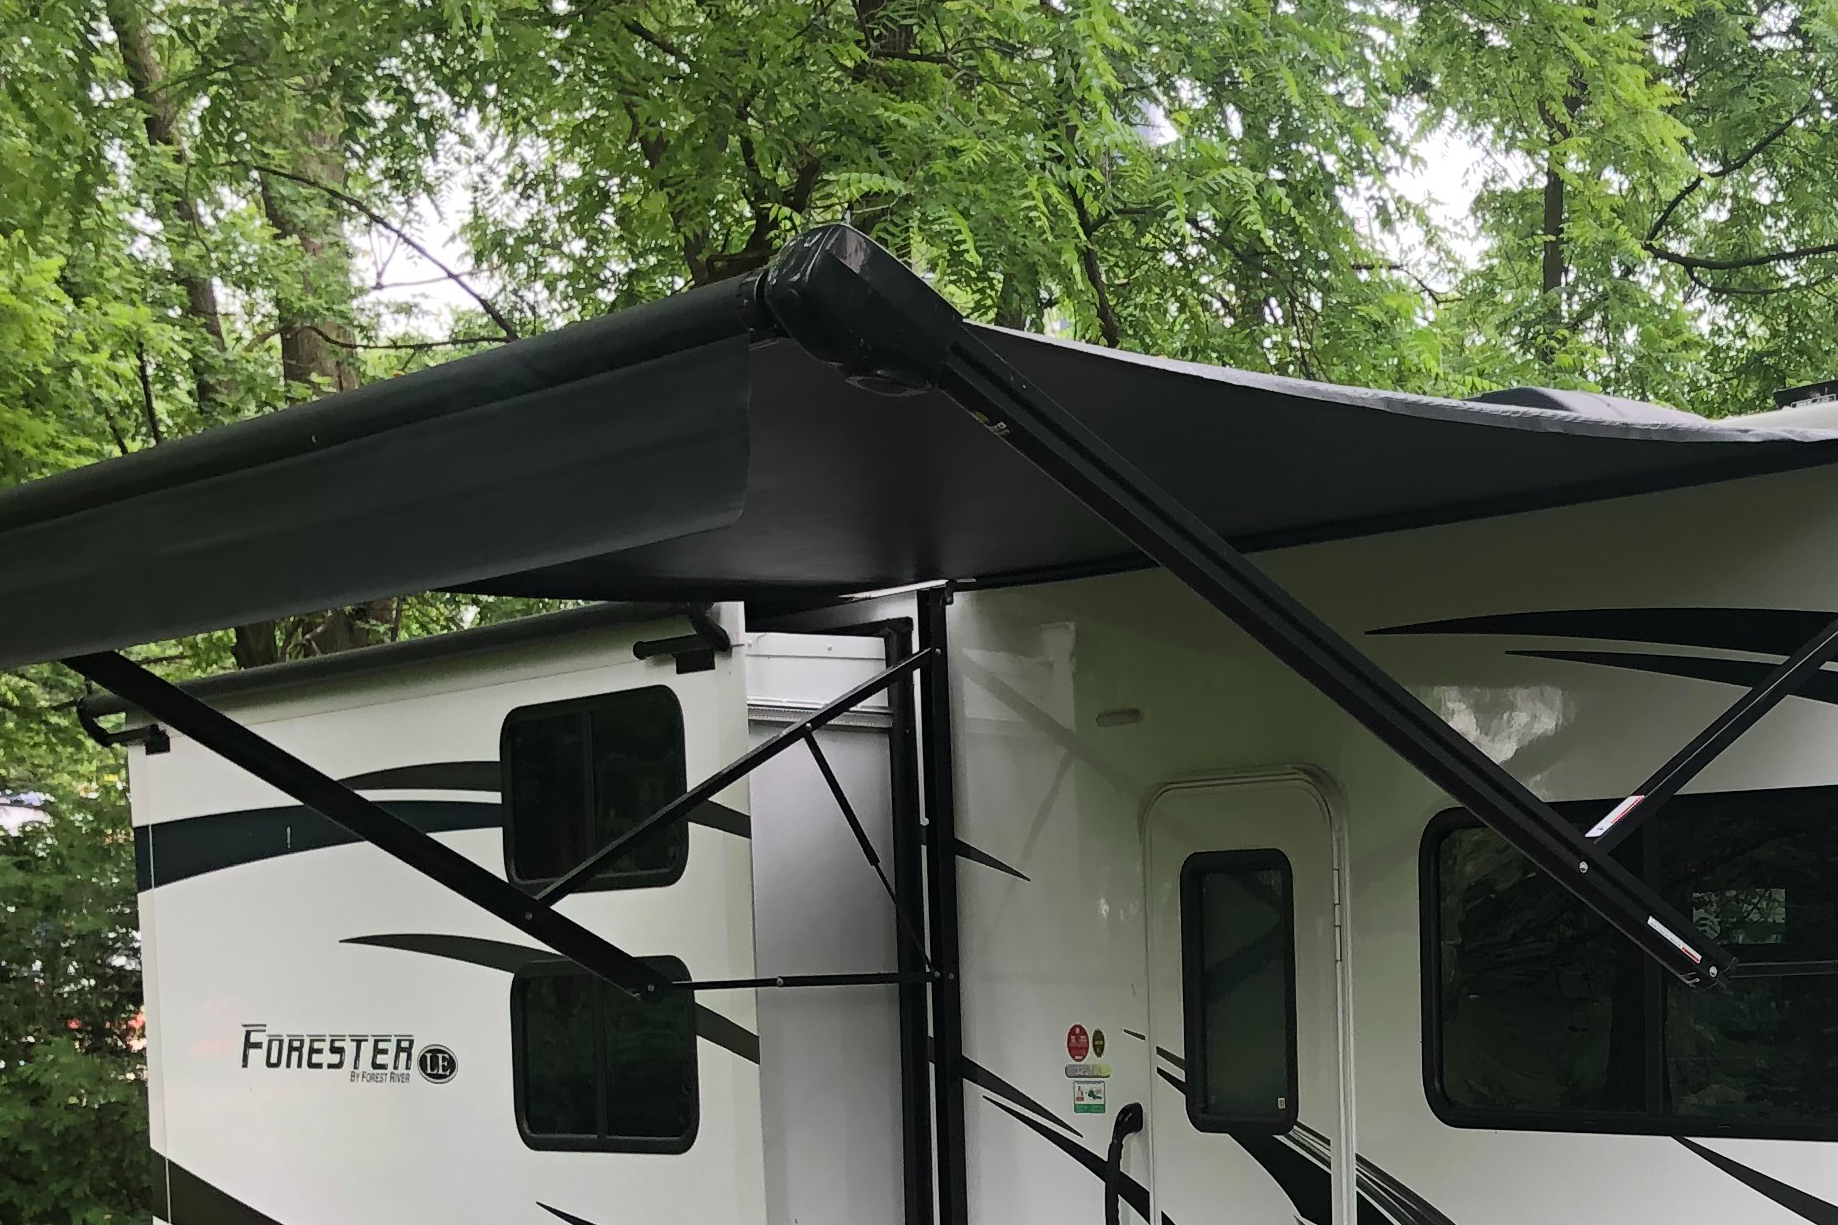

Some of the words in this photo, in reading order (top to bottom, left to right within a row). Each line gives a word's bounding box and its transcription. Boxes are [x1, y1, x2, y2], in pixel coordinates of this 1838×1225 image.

[241, 1023, 415, 1070] FORESTER
[423, 1052, 451, 1076] LE
[361, 1070, 388, 1084] FOREST
